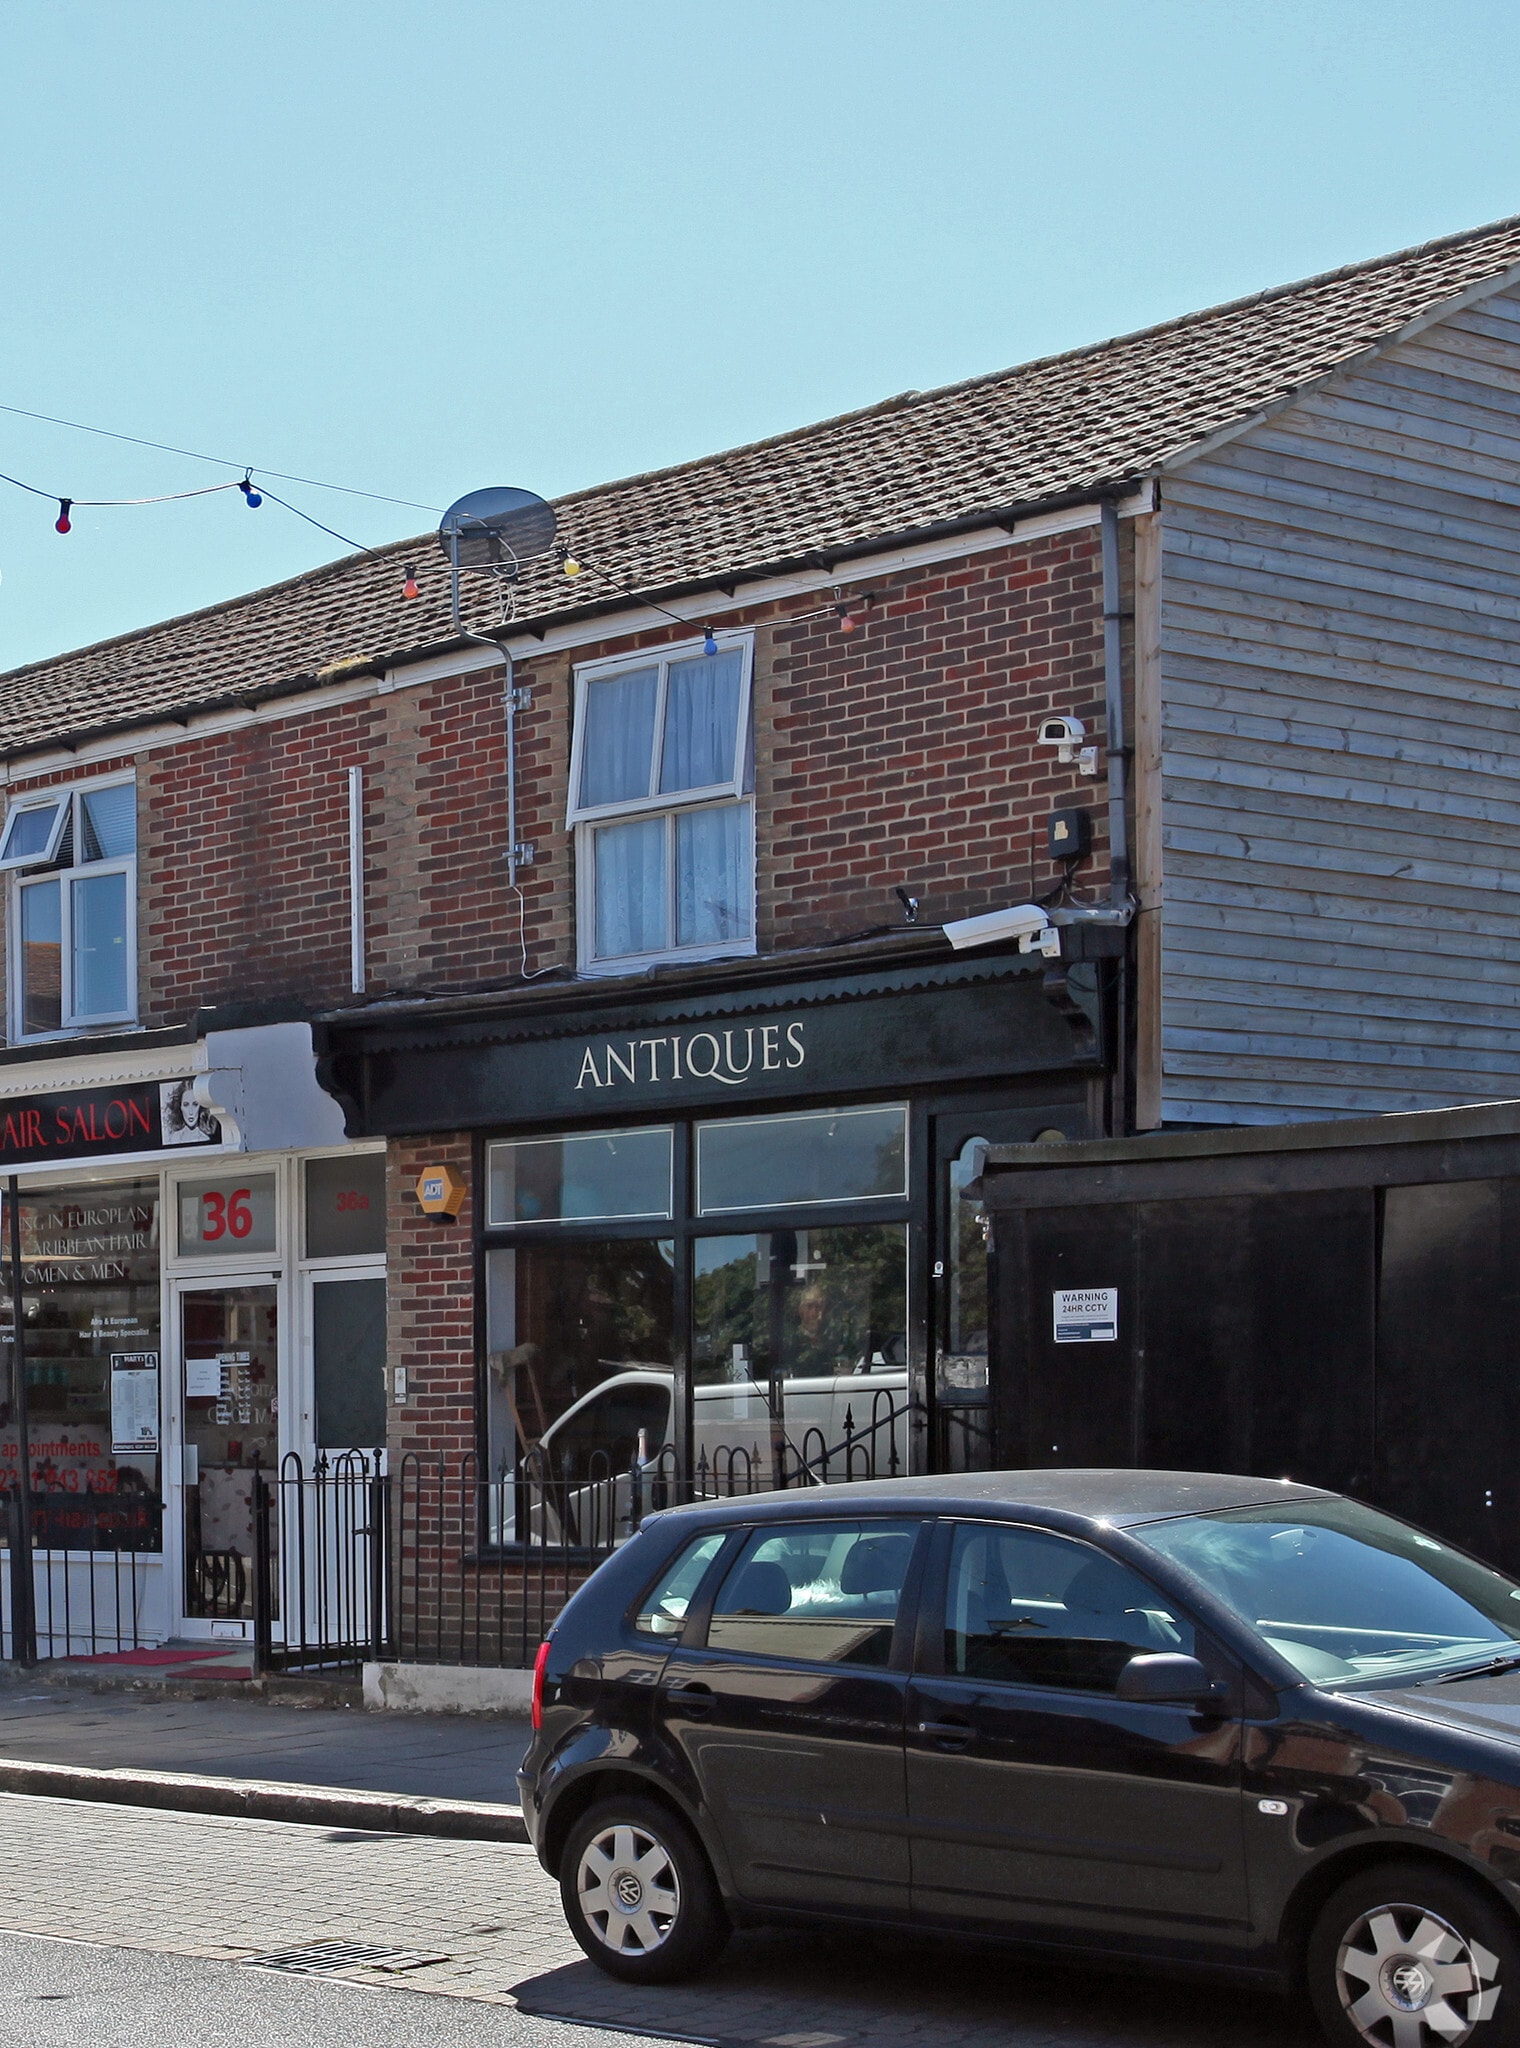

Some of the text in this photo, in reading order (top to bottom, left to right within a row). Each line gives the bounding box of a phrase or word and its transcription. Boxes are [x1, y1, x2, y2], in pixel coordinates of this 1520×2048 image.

[574, 1022, 805, 1090] ANTIQUES
[0, 1097, 150, 1149] AIR SALON
[424, 1183, 443, 1196] ADT
[336, 1191, 370, 1213] 36a
[48, 1213, 64, 1230] IN
[68, 1206, 148, 1227] EUROPEAN
[203, 1188, 253, 1241] 36
[110, 1233, 147, 1251] HAIR
[72, 1265, 85, 1281] &
[91, 1262, 125, 1280] MEN
[1062, 1292, 1108, 1302] WARNING
[1062, 1303, 1108, 1313] 24HR CCTV
[2, 1440, 101, 1458] apointments
